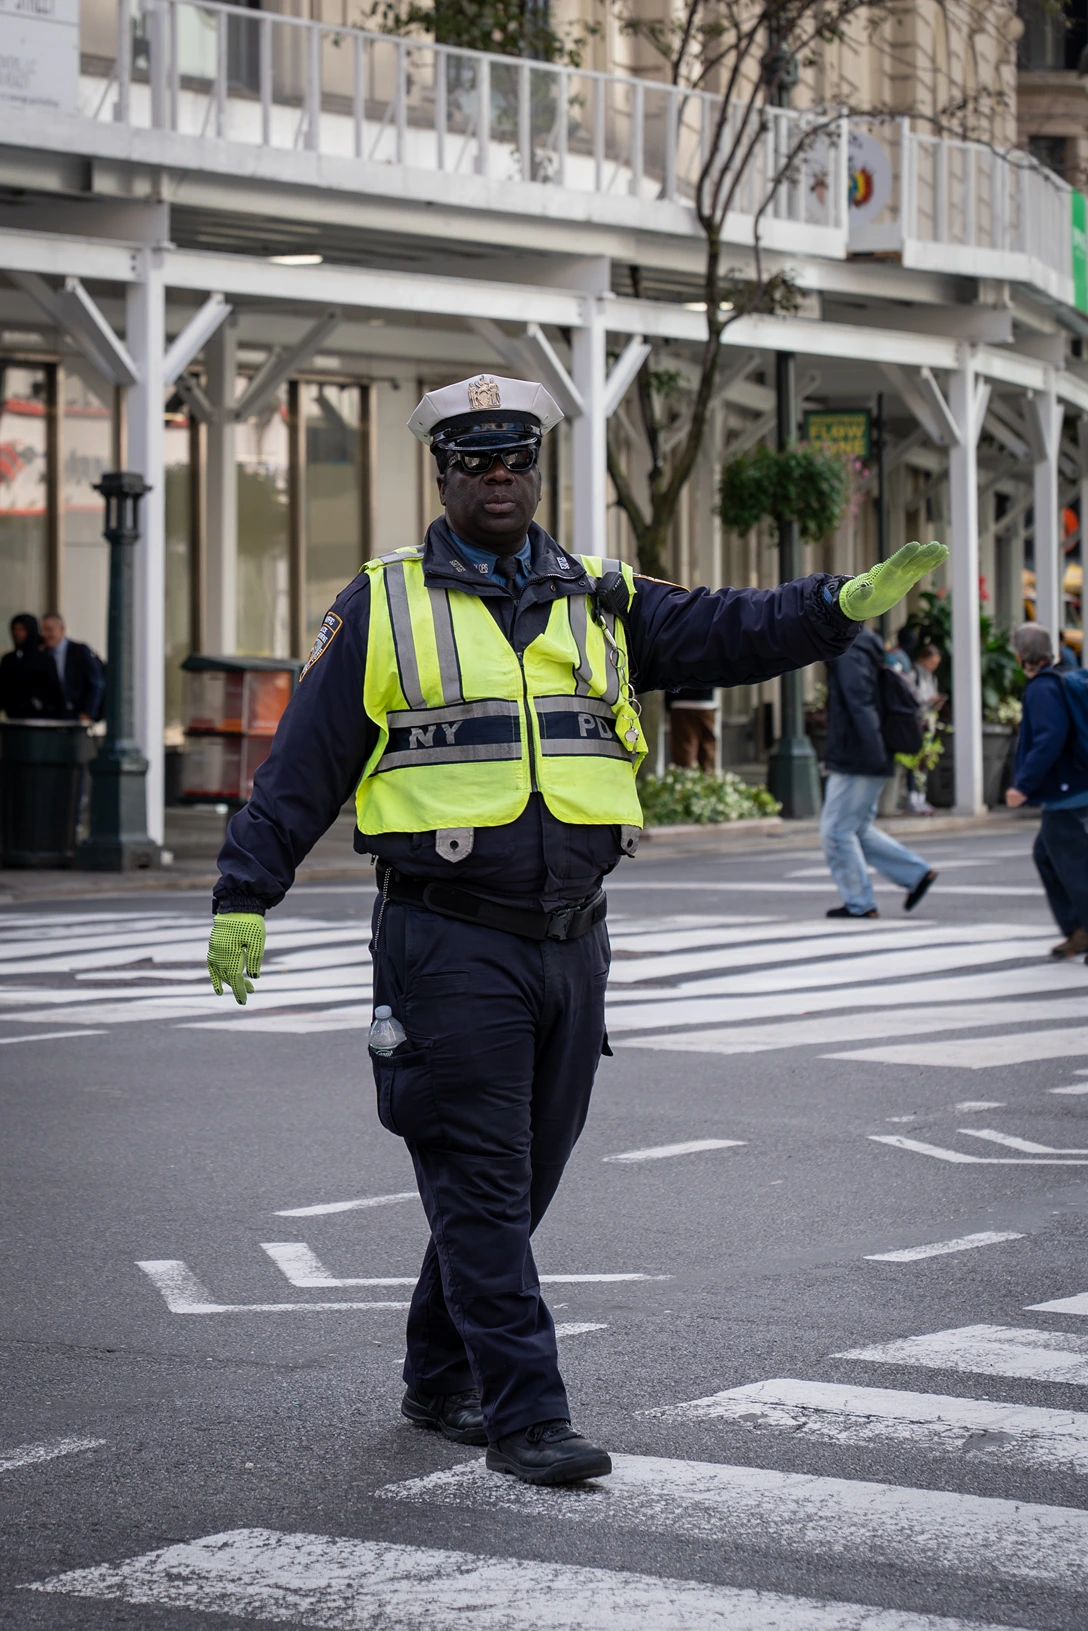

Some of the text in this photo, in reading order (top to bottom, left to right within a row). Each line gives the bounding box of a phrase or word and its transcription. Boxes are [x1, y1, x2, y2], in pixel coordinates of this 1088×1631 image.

[809, 424, 865, 440] FLOW
[409, 713, 613, 749] NY PD
